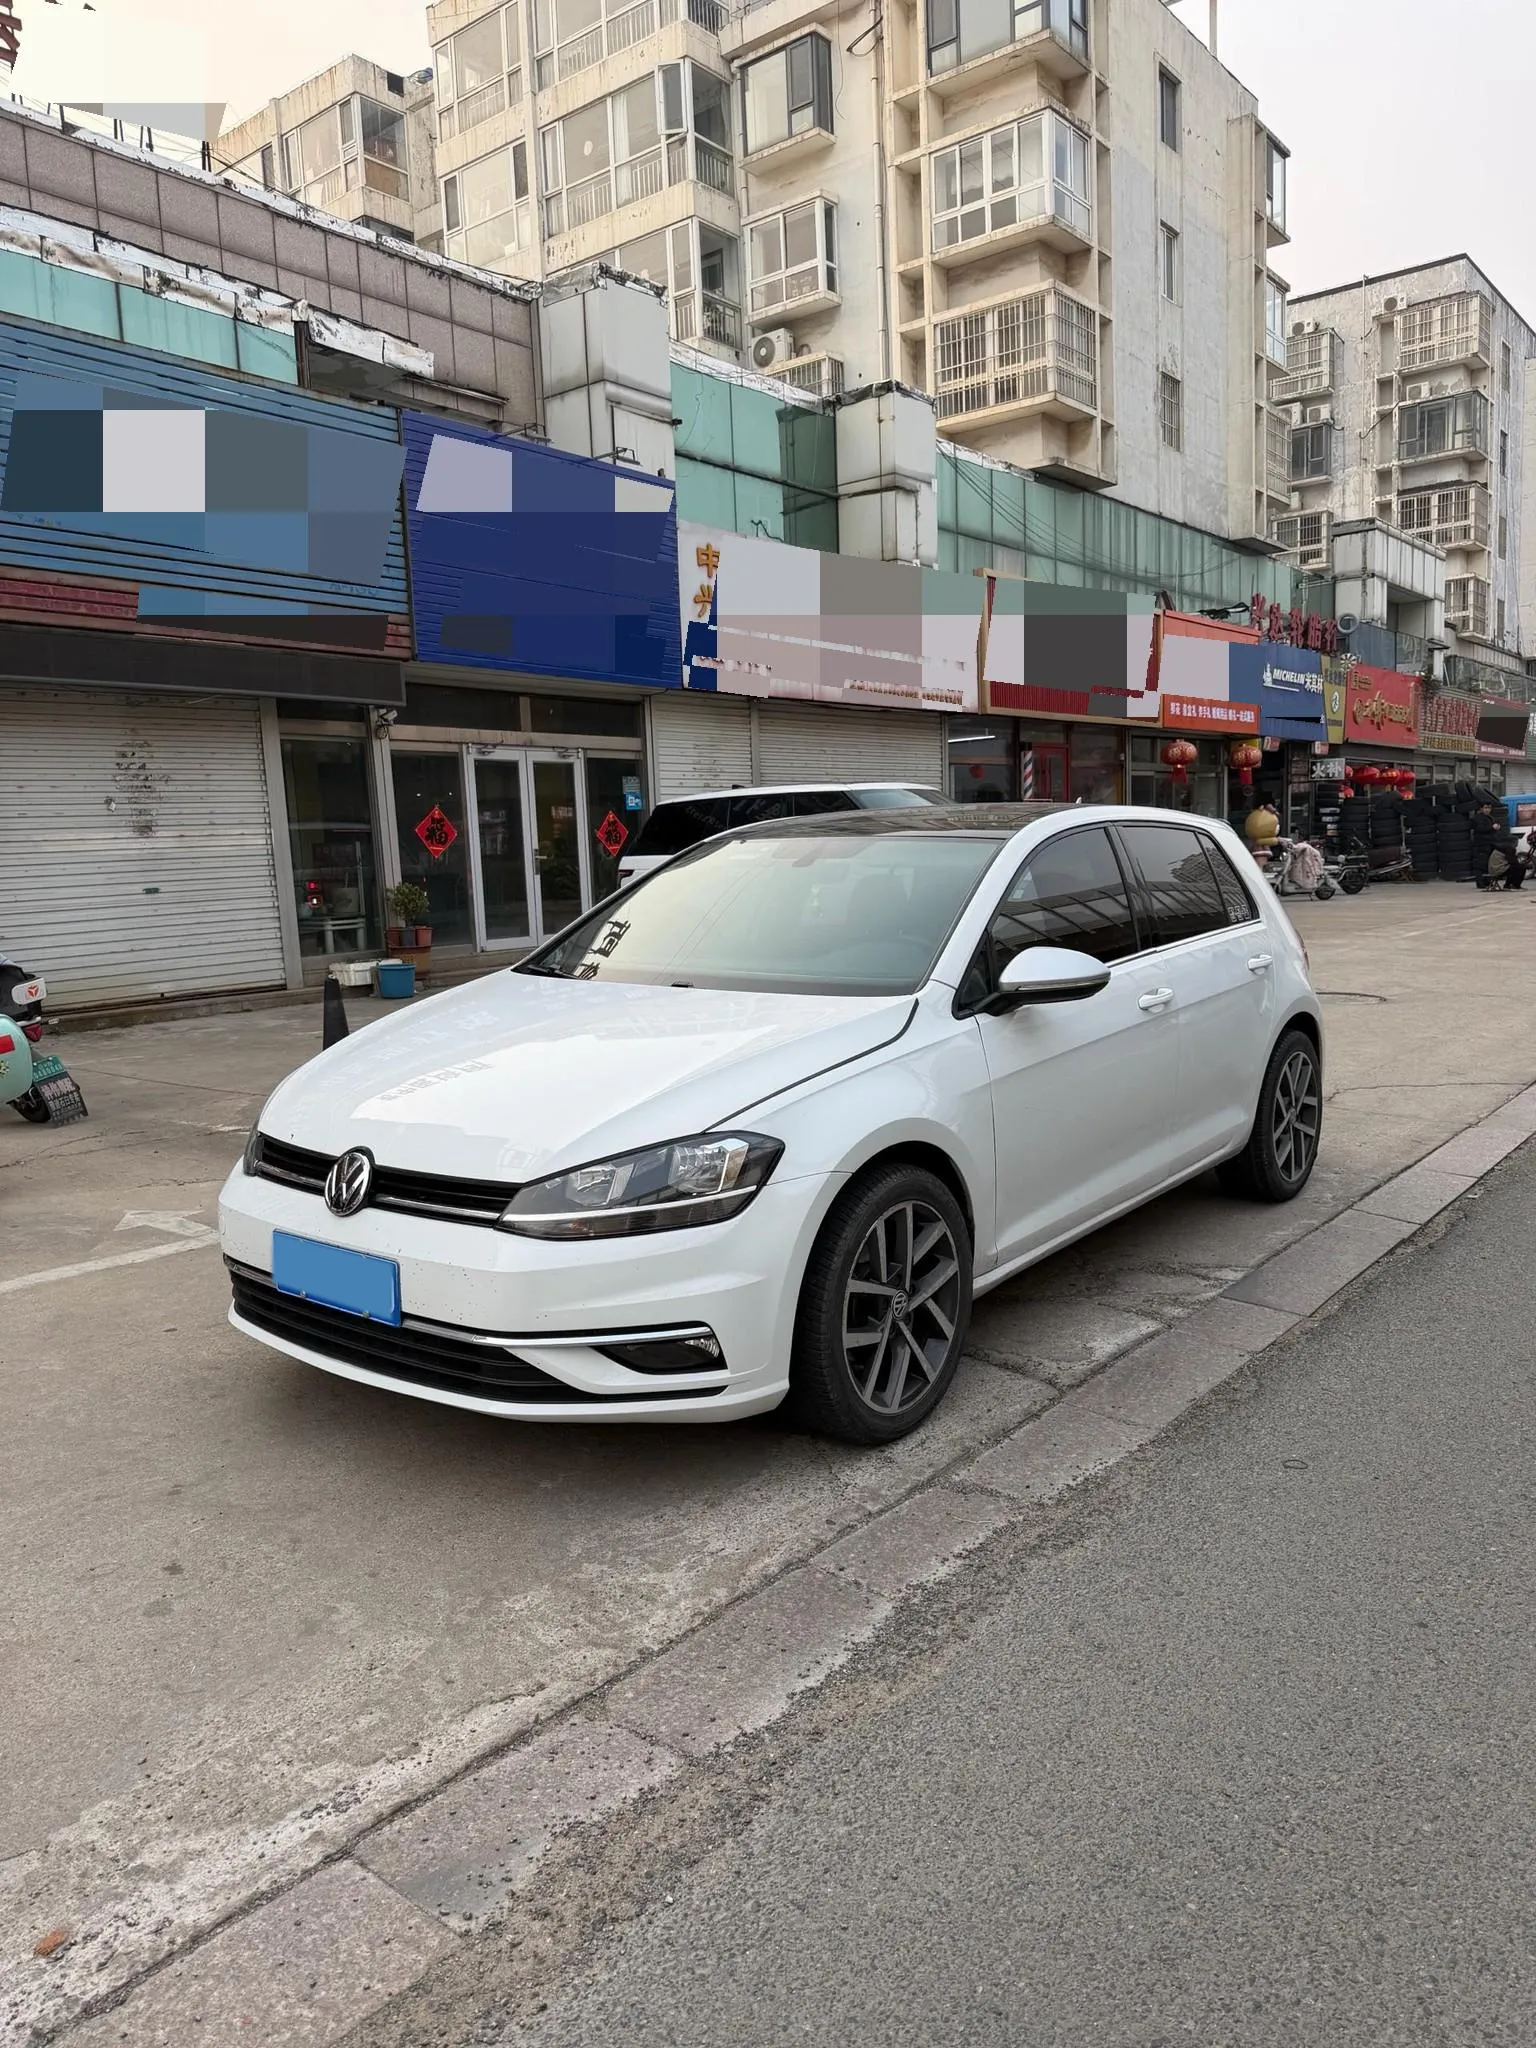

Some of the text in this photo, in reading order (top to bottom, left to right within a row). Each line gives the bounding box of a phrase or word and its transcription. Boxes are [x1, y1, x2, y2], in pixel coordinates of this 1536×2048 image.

[1273, 668, 1305, 684] MICHELIN
[1305, 672, 1323, 693] 米其林
[1311, 760, 1341, 778] 火补
[425, 817, 448, 846] 福
